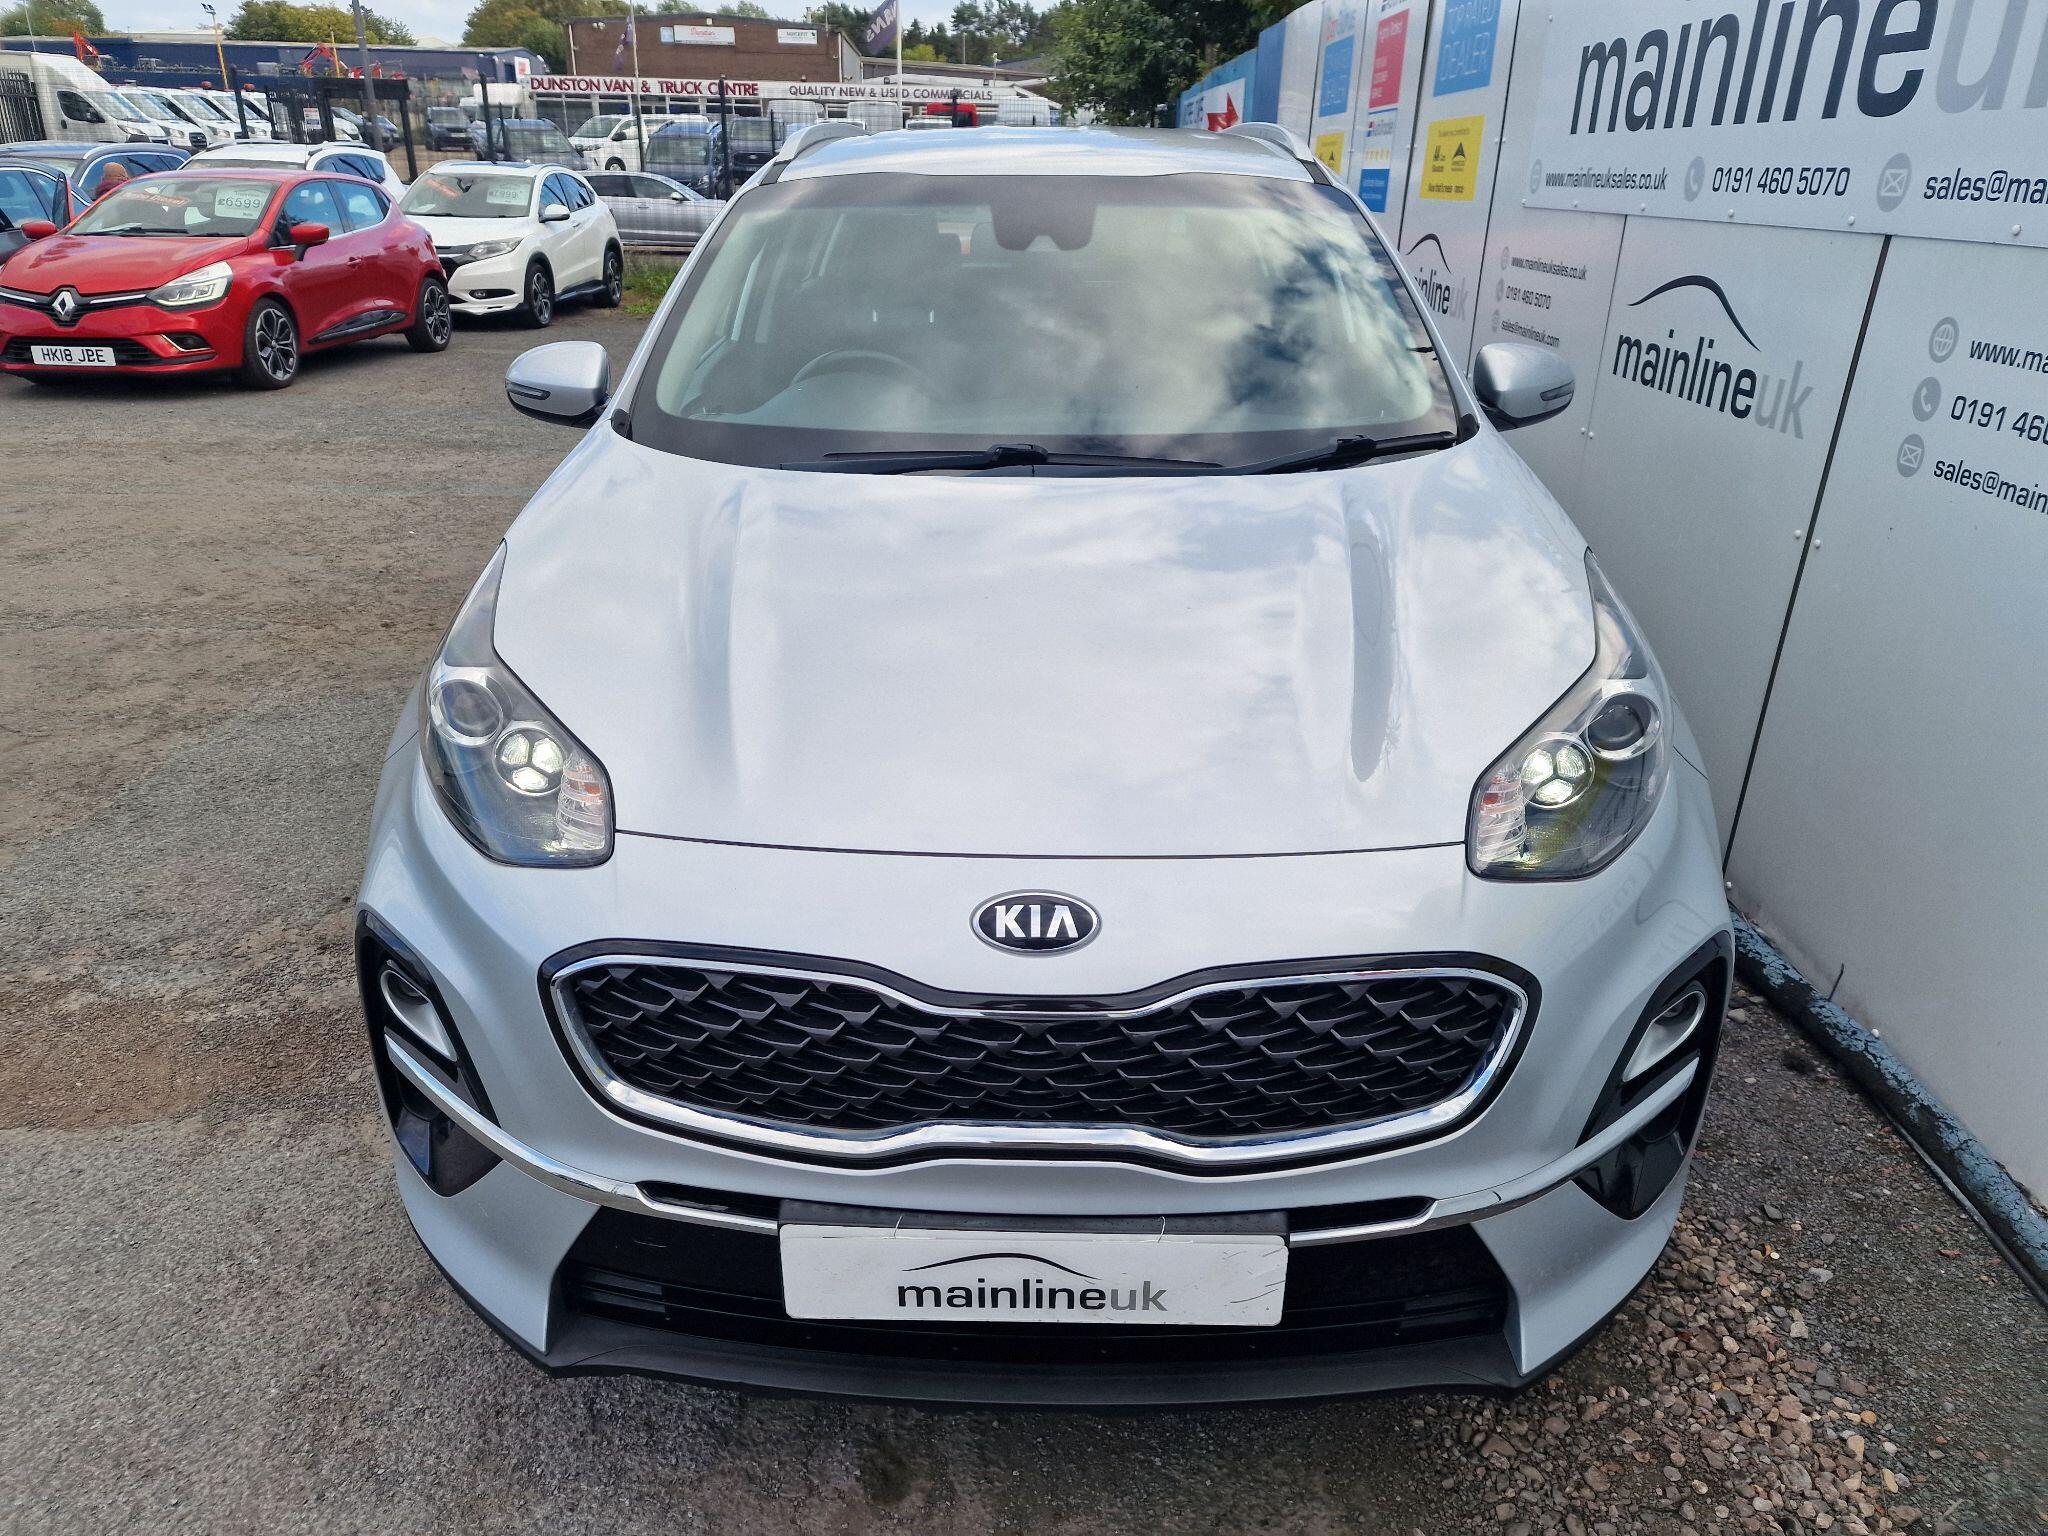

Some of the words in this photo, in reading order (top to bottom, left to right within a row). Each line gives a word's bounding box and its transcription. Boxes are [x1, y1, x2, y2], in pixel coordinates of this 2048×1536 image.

[1570, 0, 2048, 135] mainlineu
[530, 76, 601, 92] DUNSTON
[602, 79, 635, 93] VAN
[640, 80, 651, 93] &
[658, 80, 703, 95] TRUCK
[707, 82, 759, 97] CNTRE
[789, 85, 836, 96] QUALITY
[839, 86, 866, 97] NEW
[869, 87, 877, 98] &
[913, 88, 993, 100] COMMCIALS
[1545, 167, 1668, 190] www.mainlineuksales.co.uk
[1712, 166, 1753, 193] 0191
[1757, 166, 1794, 194] 460
[1796, 166, 1851, 196] 5070
[1923, 167, 2048, 204] sales@ma
[1505, 285, 1521, 301] 0191
[1521, 289, 1535, 306] 460
[1534, 292, 1552, 310] 5070
[41, 347, 74, 362] HK18
[78, 348, 106, 363] JBE
[1612, 329, 1814, 440] mainlineuk
[1950, 395, 2007, 432] 0191
[1933, 459, 2048, 515] sales@main
[994, 903, 1080, 939] KIA
[897, 1278, 1169, 1312] mainlineuk
